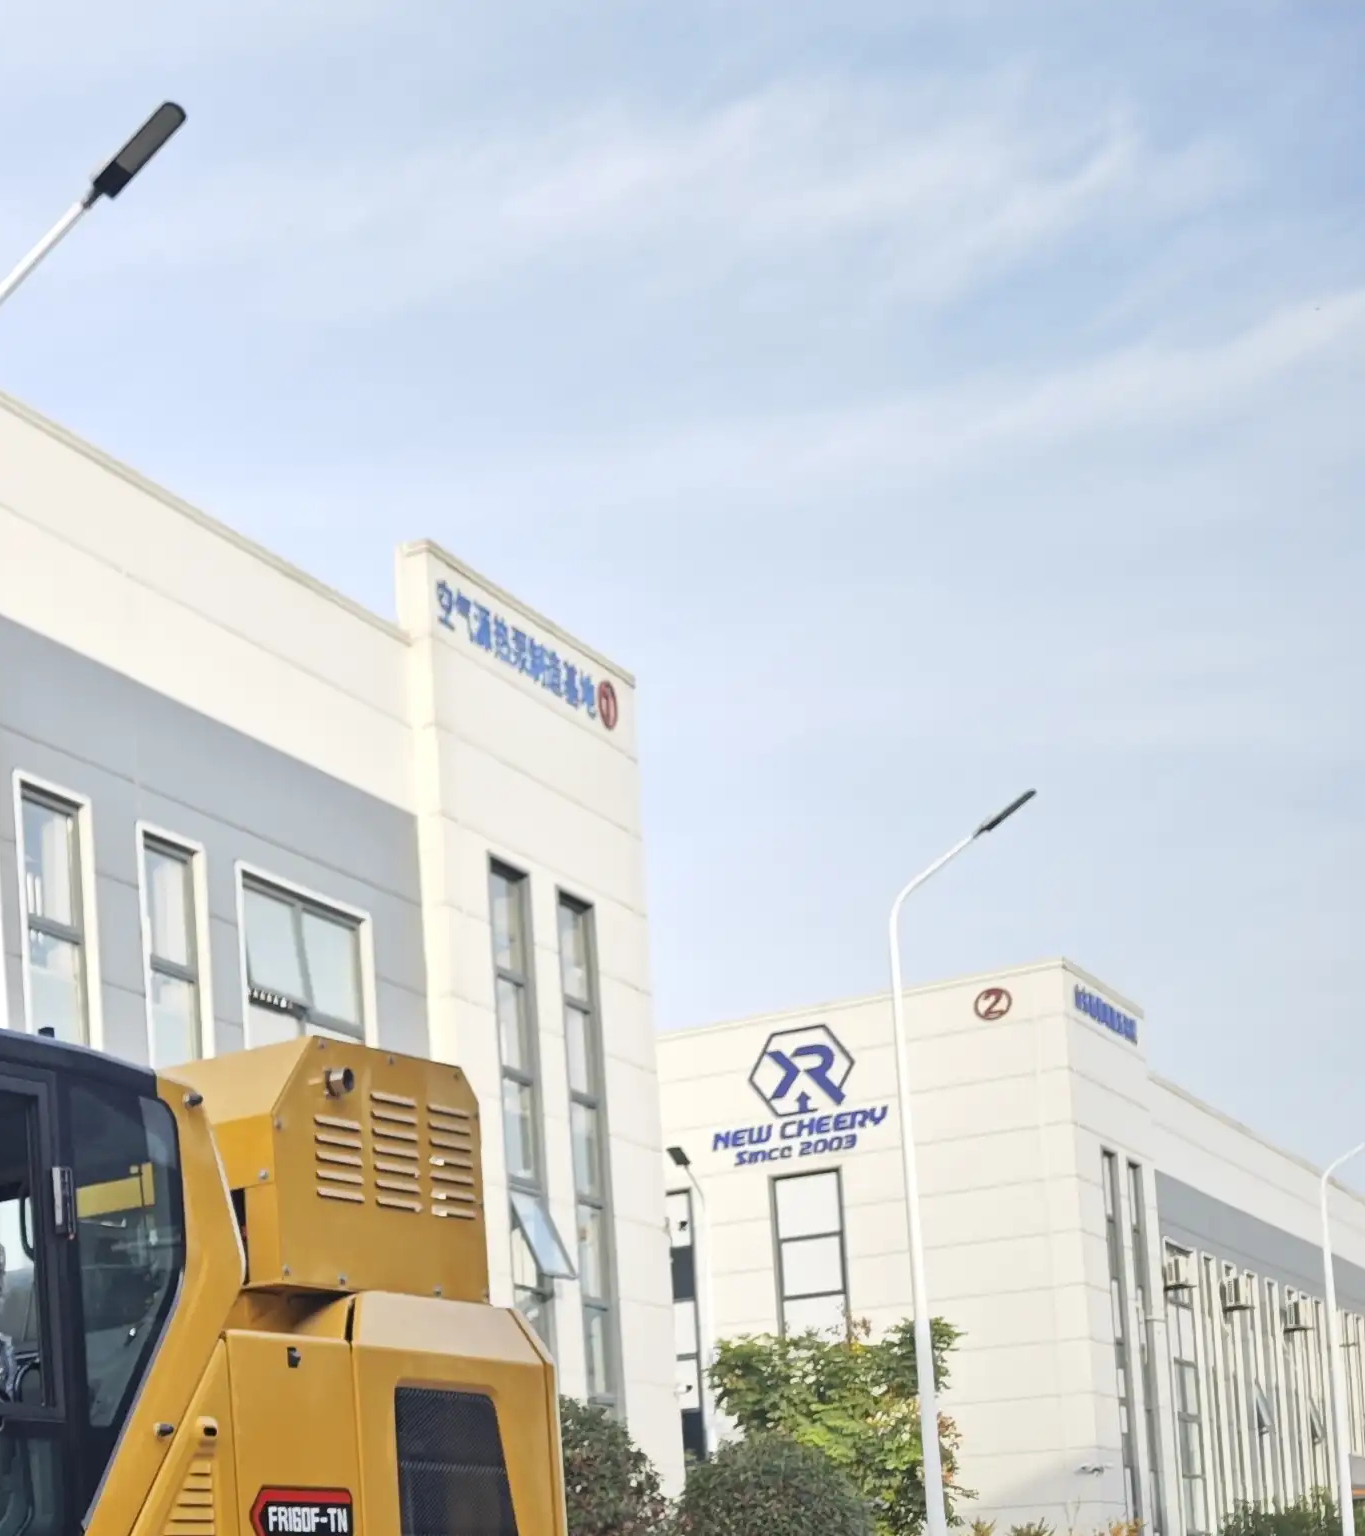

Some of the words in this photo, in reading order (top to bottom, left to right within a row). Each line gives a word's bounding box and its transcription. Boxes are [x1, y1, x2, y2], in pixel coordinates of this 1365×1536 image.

[712, 1124, 772, 1151] NEW
[780, 1105, 889, 1140] CHEERY
[799, 1133, 858, 1157] 2003
